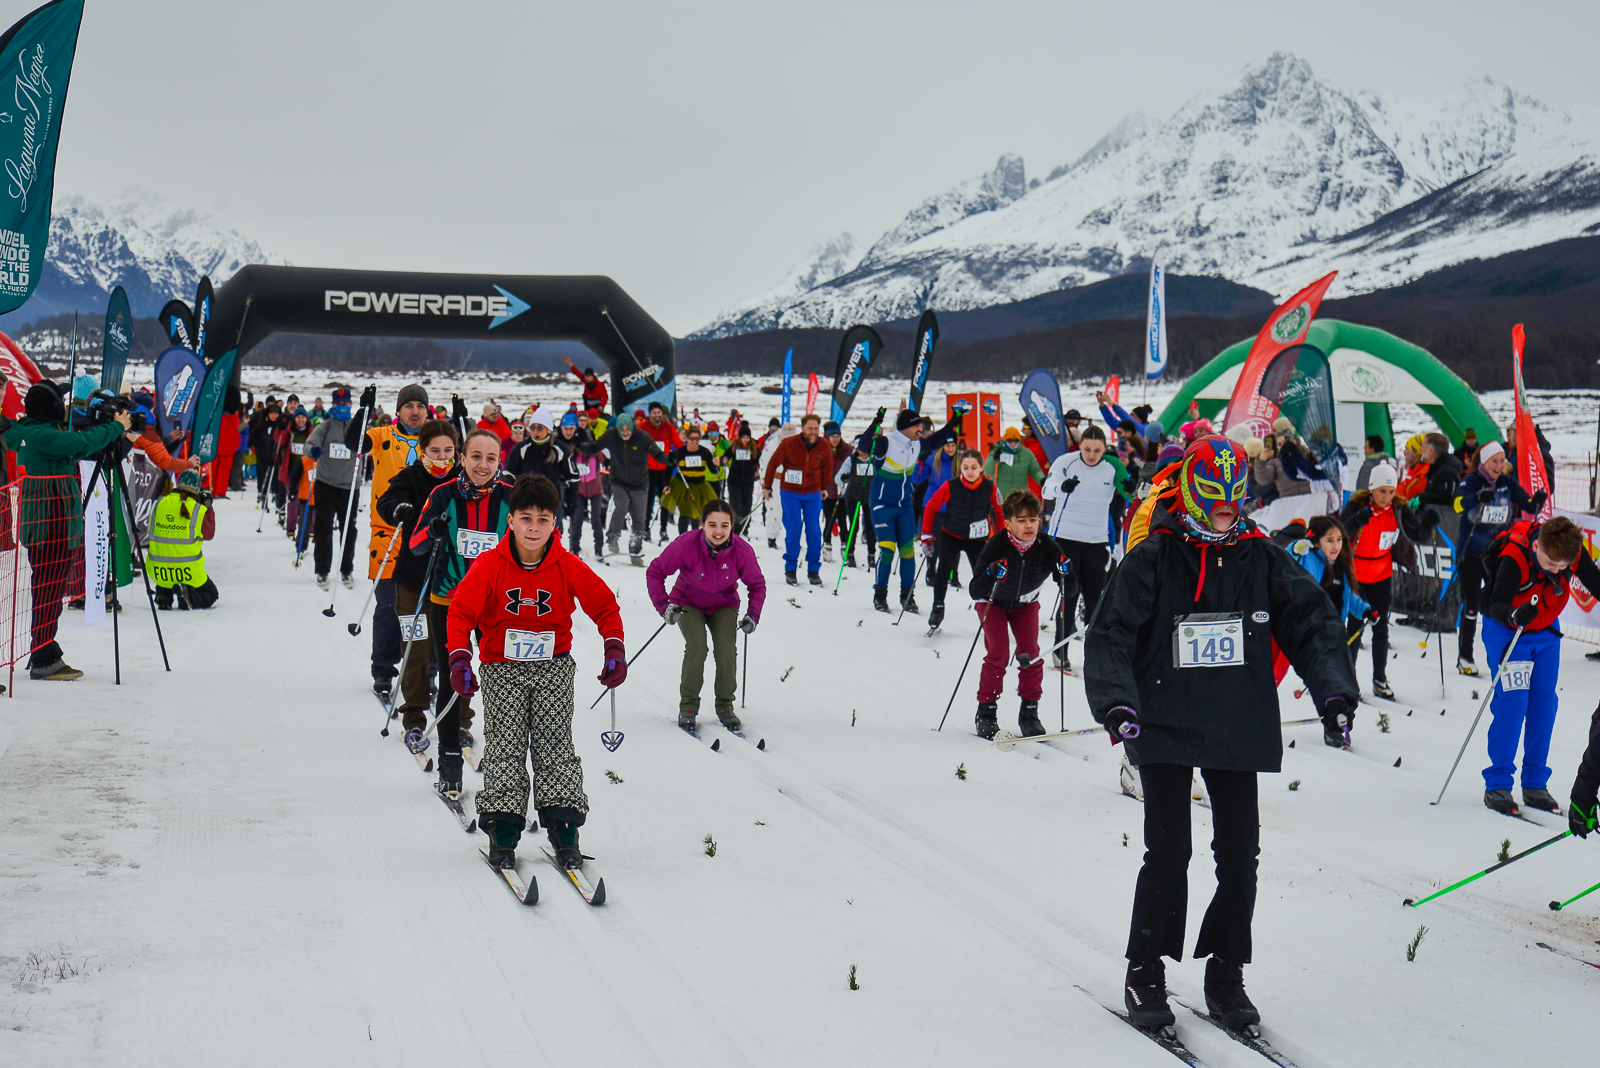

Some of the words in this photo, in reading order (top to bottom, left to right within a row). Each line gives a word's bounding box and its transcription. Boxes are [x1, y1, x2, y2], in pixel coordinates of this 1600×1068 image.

[14, 43, 52, 121] Negra
[5, 112, 41, 213] Laguna
[7, 261, 30, 273] THE
[325, 290, 509, 316] POWERADE
[838, 342, 865, 393] POWER
[913, 331, 930, 388] POWER
[621, 364, 659, 385] POWER
[170, 389, 185, 416] TIERRA
[334, 450, 348, 458] 171
[787, 474, 800, 484] 185
[1485, 511, 1505, 524] 125
[156, 522, 187, 531] Phoutdoor
[973, 525, 987, 537] 147
[461, 540, 492, 556] 135
[153, 566, 193, 583] FOTOS
[512, 641, 546, 658] 174
[1187, 637, 1235, 663] 149
[1504, 671, 1530, 688] 180
